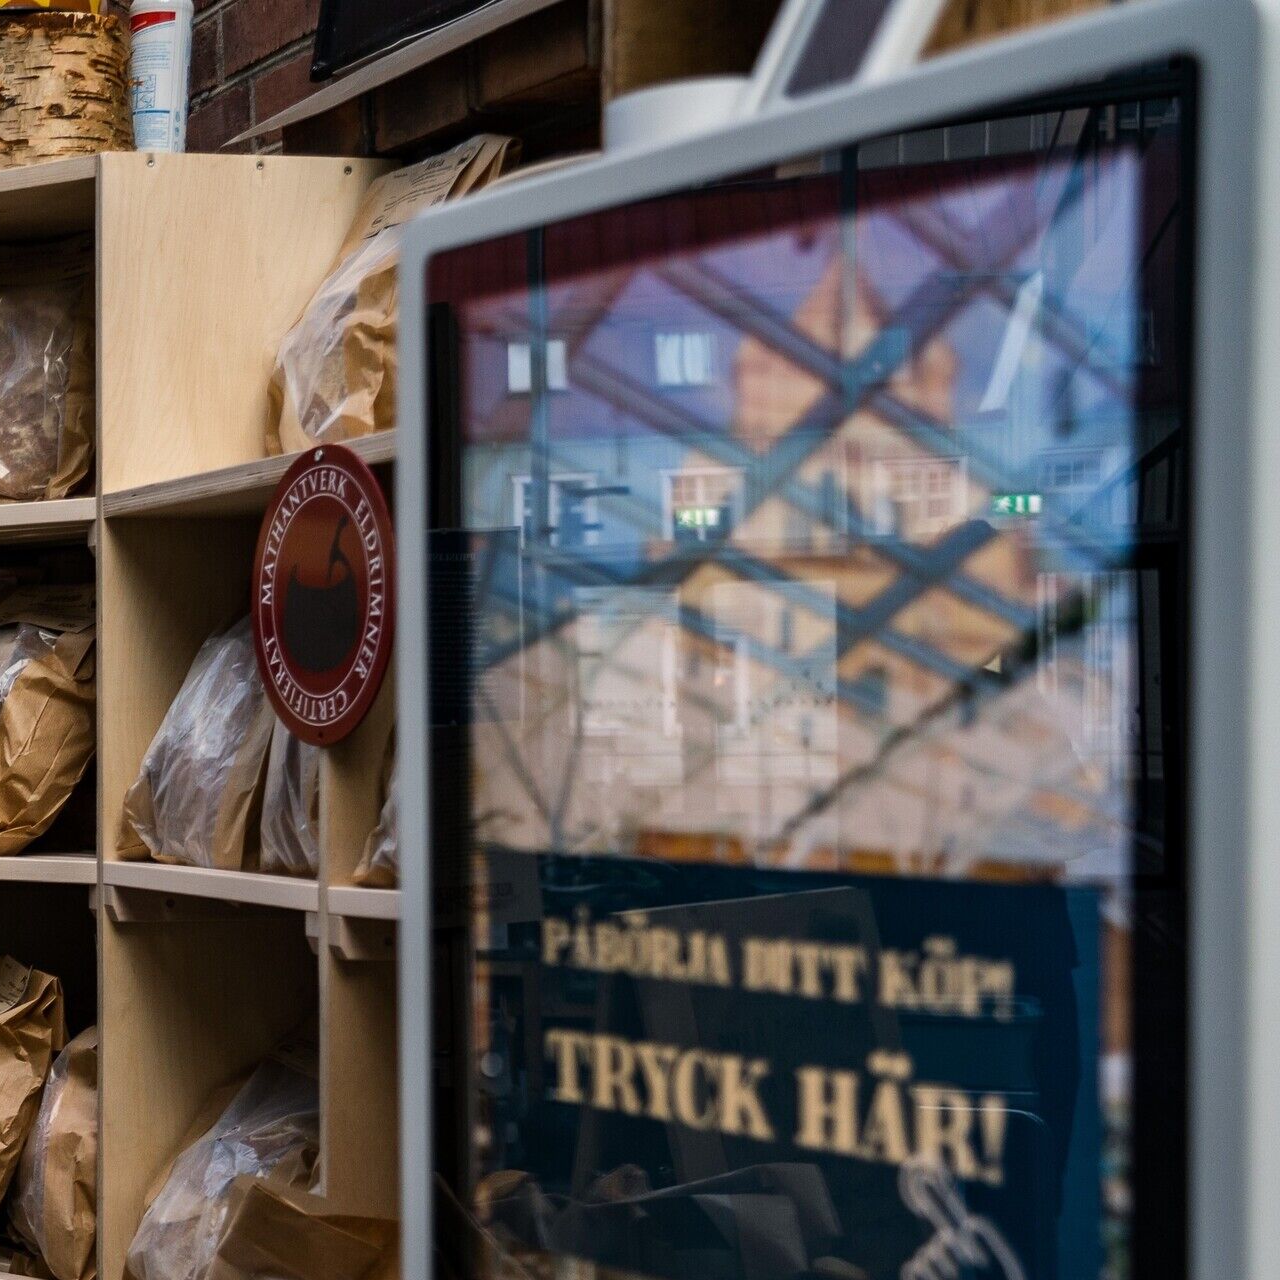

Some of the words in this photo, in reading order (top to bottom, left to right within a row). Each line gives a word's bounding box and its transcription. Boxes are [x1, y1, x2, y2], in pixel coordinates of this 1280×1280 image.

[261, 469, 348, 606] MATHANTVERK
[353, 499, 385, 680] ELDRIMNER
[264, 636, 349, 721] CERTIFIERAT
[542, 903, 732, 986] PÅBÖRJA
[742, 933, 870, 1001] DITT
[876, 933, 1018, 1022] KÖP!
[545, 1027, 775, 1143] TRYCK
[793, 1050, 1008, 1188] HÄR!
